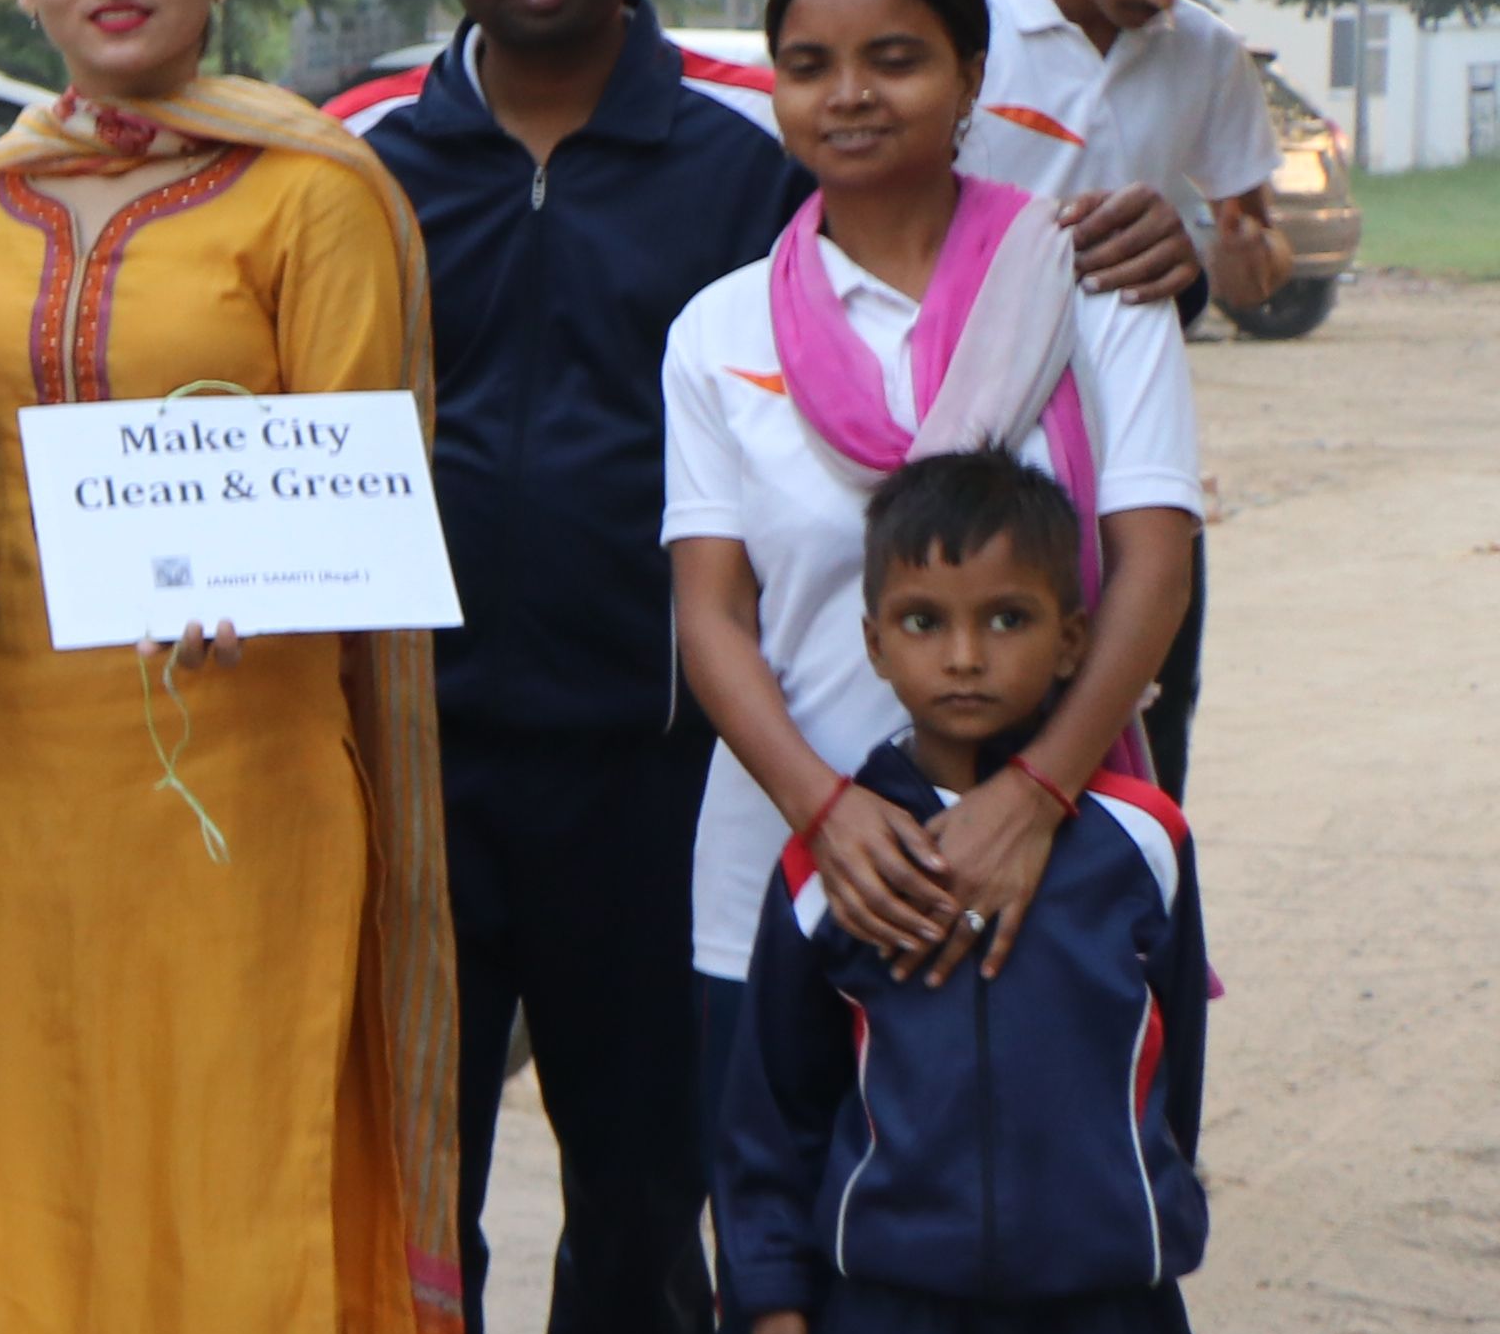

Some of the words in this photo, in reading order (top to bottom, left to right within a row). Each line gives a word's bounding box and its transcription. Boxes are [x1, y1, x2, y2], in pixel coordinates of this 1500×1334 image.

[120, 419, 247, 457] Make
[261, 417, 352, 456] City
[75, 475, 206, 511] Clean
[221, 470, 258, 502] &
[271, 466, 414, 501] Green
